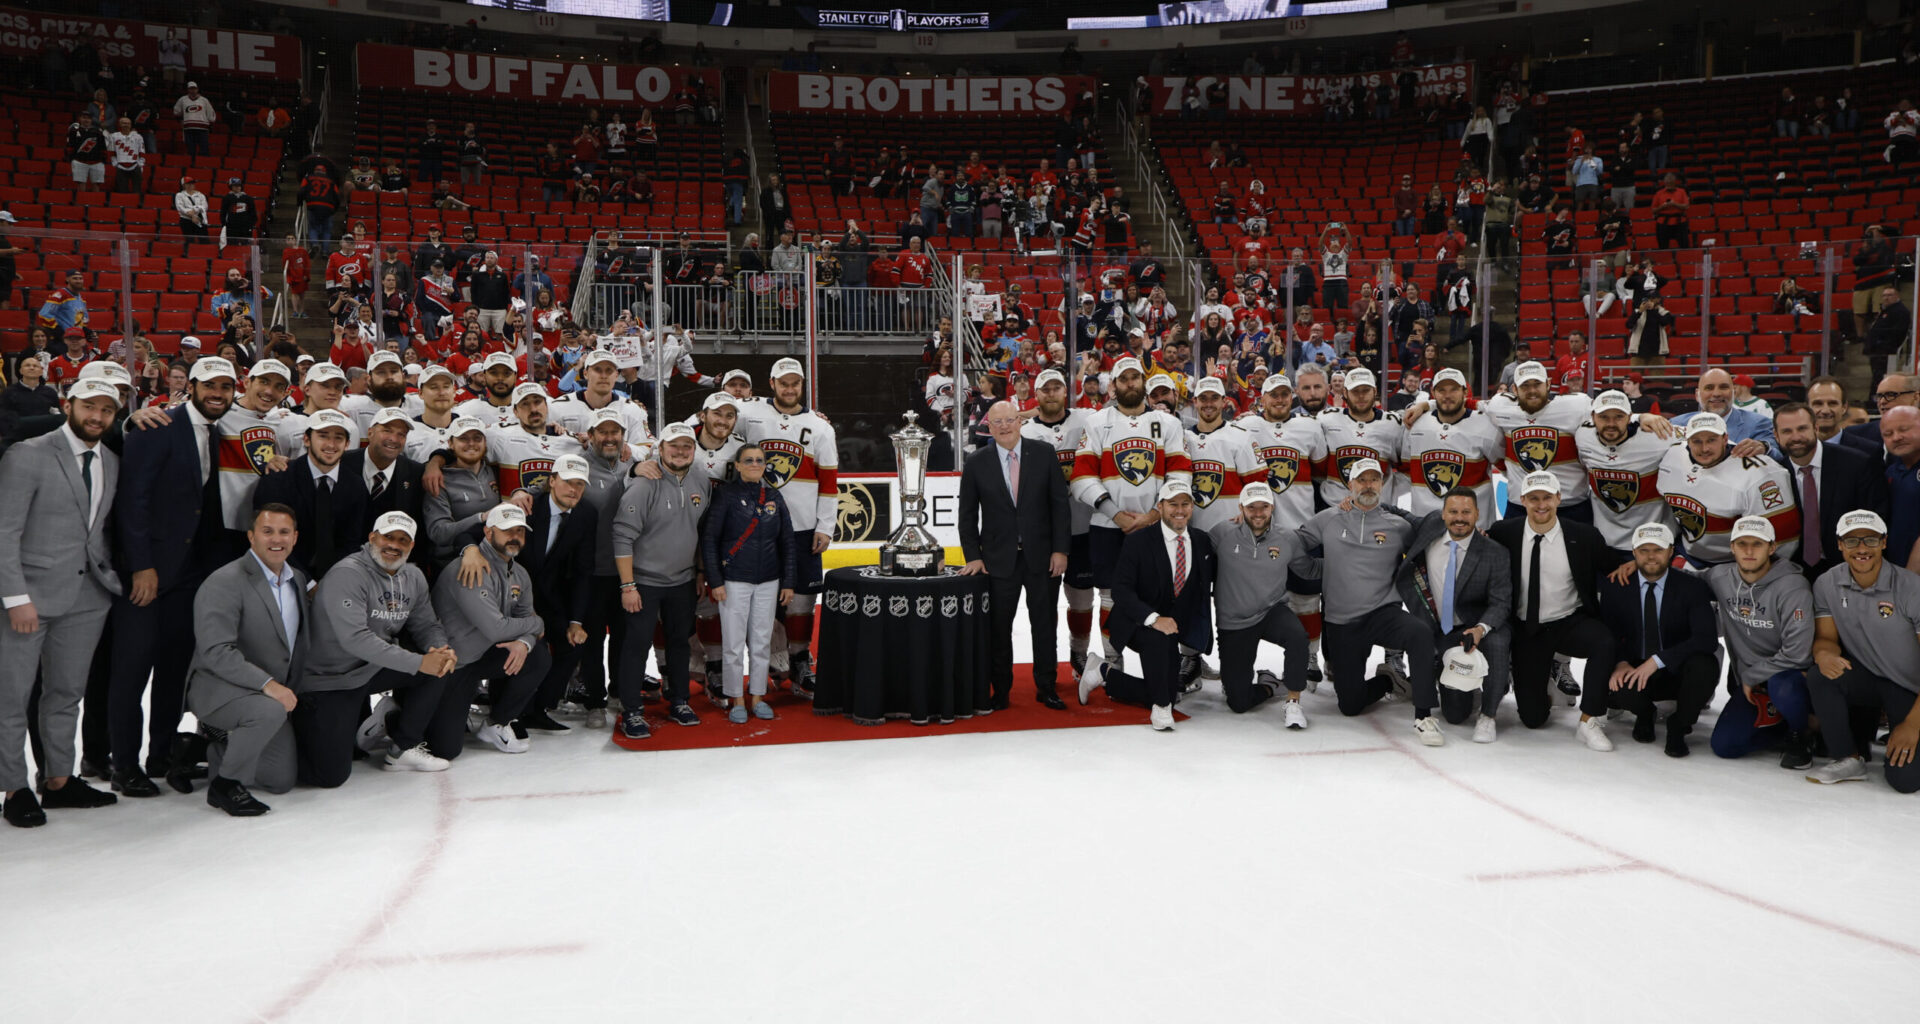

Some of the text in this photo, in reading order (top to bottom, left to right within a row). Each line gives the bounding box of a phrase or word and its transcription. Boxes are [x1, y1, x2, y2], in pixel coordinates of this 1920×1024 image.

[539, 15, 555, 26] 111
[819, 13, 865, 24] STANLEY
[868, 15, 889, 25] CUP
[908, 16, 961, 26] PLAYOFFS
[114, 25, 132, 40] &
[918, 36, 934, 46] 112
[144, 25, 276, 73] THE
[413, 48, 671, 102] BUFFALO
[798, 74, 1067, 112] BROTHERS
[800, 427, 812, 446] C
[1151, 422, 1161, 438] A
[1515, 429, 1553, 438] FLORIDA
[763, 442, 800, 455] FLORIDA
[1116, 440, 1153, 451] FLORIDA
[1266, 449, 1297, 459] LORIDA
[1340, 448, 1376, 459] FLORIDA
[1425, 452, 1461, 462] FLORIDA
[1595, 471, 1634, 480] FLORIDA
[1667, 496, 1702, 515] FLORIDA
